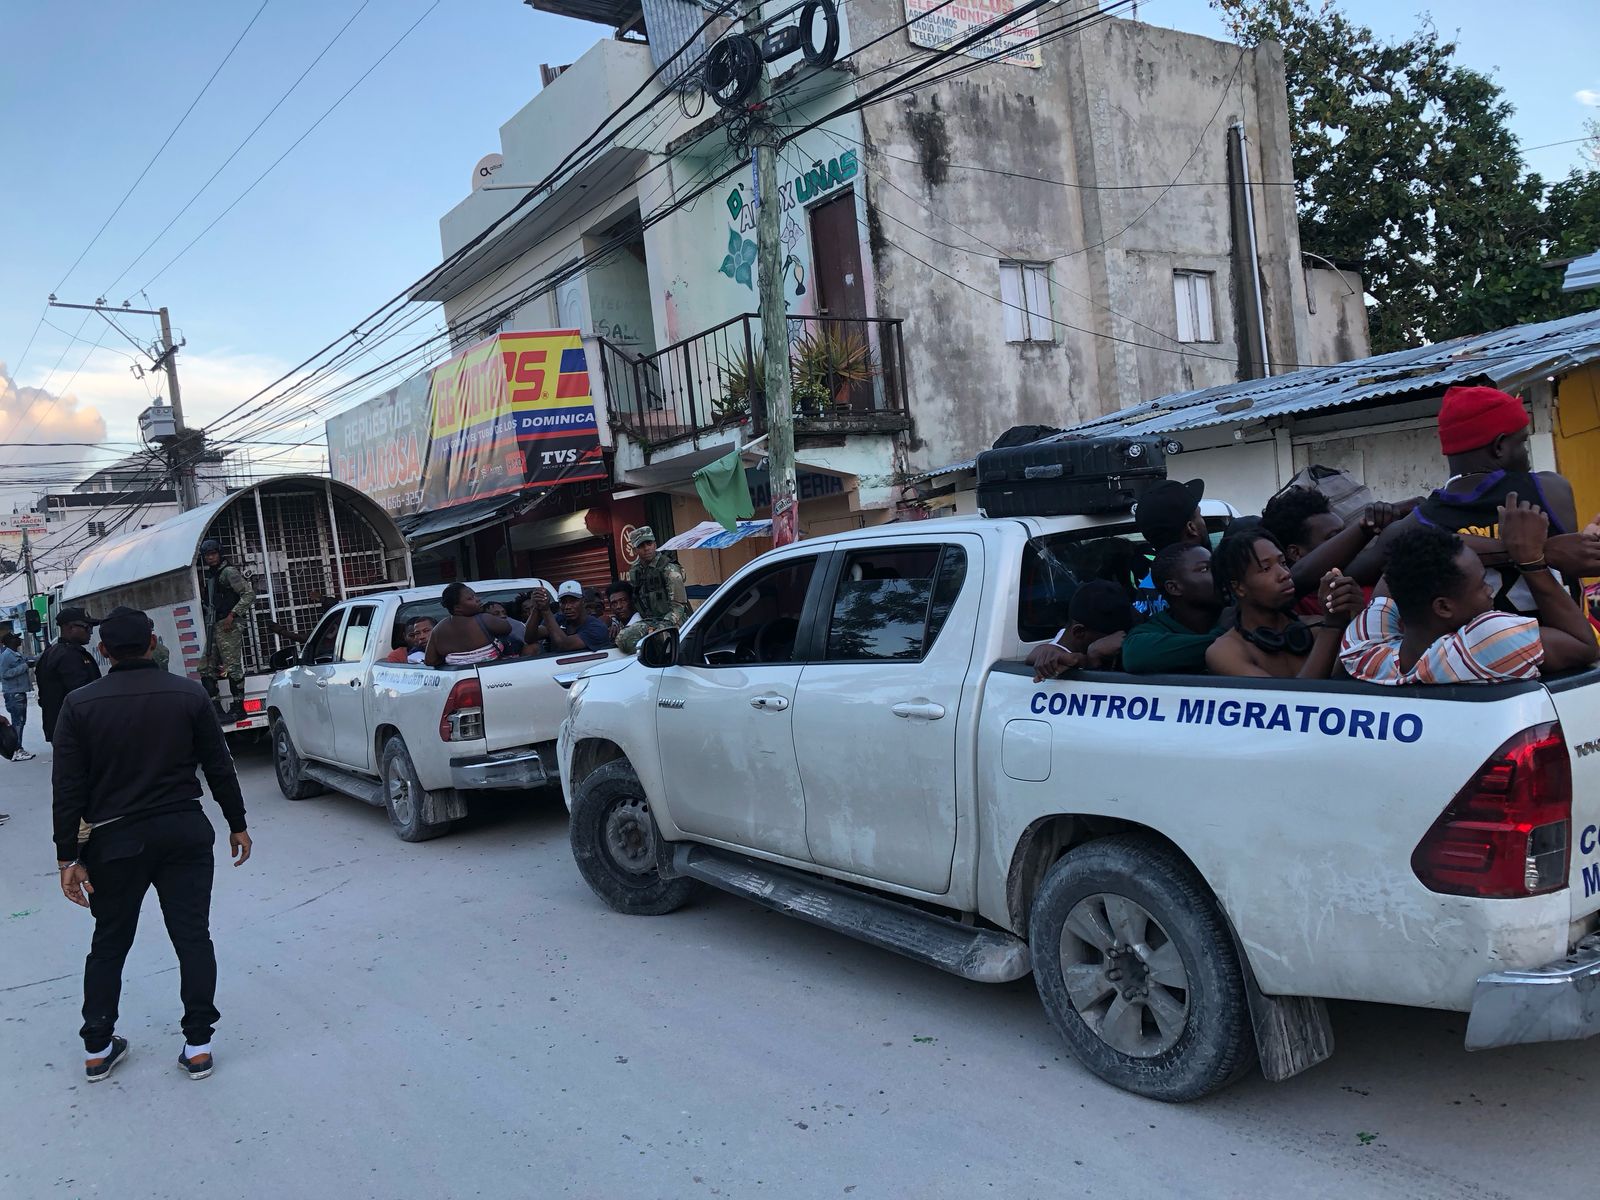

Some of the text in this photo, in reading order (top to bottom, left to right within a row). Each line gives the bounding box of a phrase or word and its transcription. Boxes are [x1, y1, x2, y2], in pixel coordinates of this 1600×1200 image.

[795, 150, 858, 203] UÑAS
[504, 419, 518, 432] LOS
[540, 449, 577, 465] TVS
[1030, 691, 1423, 743] CONTROL MIGRATORIO
[1580, 824, 1600, 856] C
